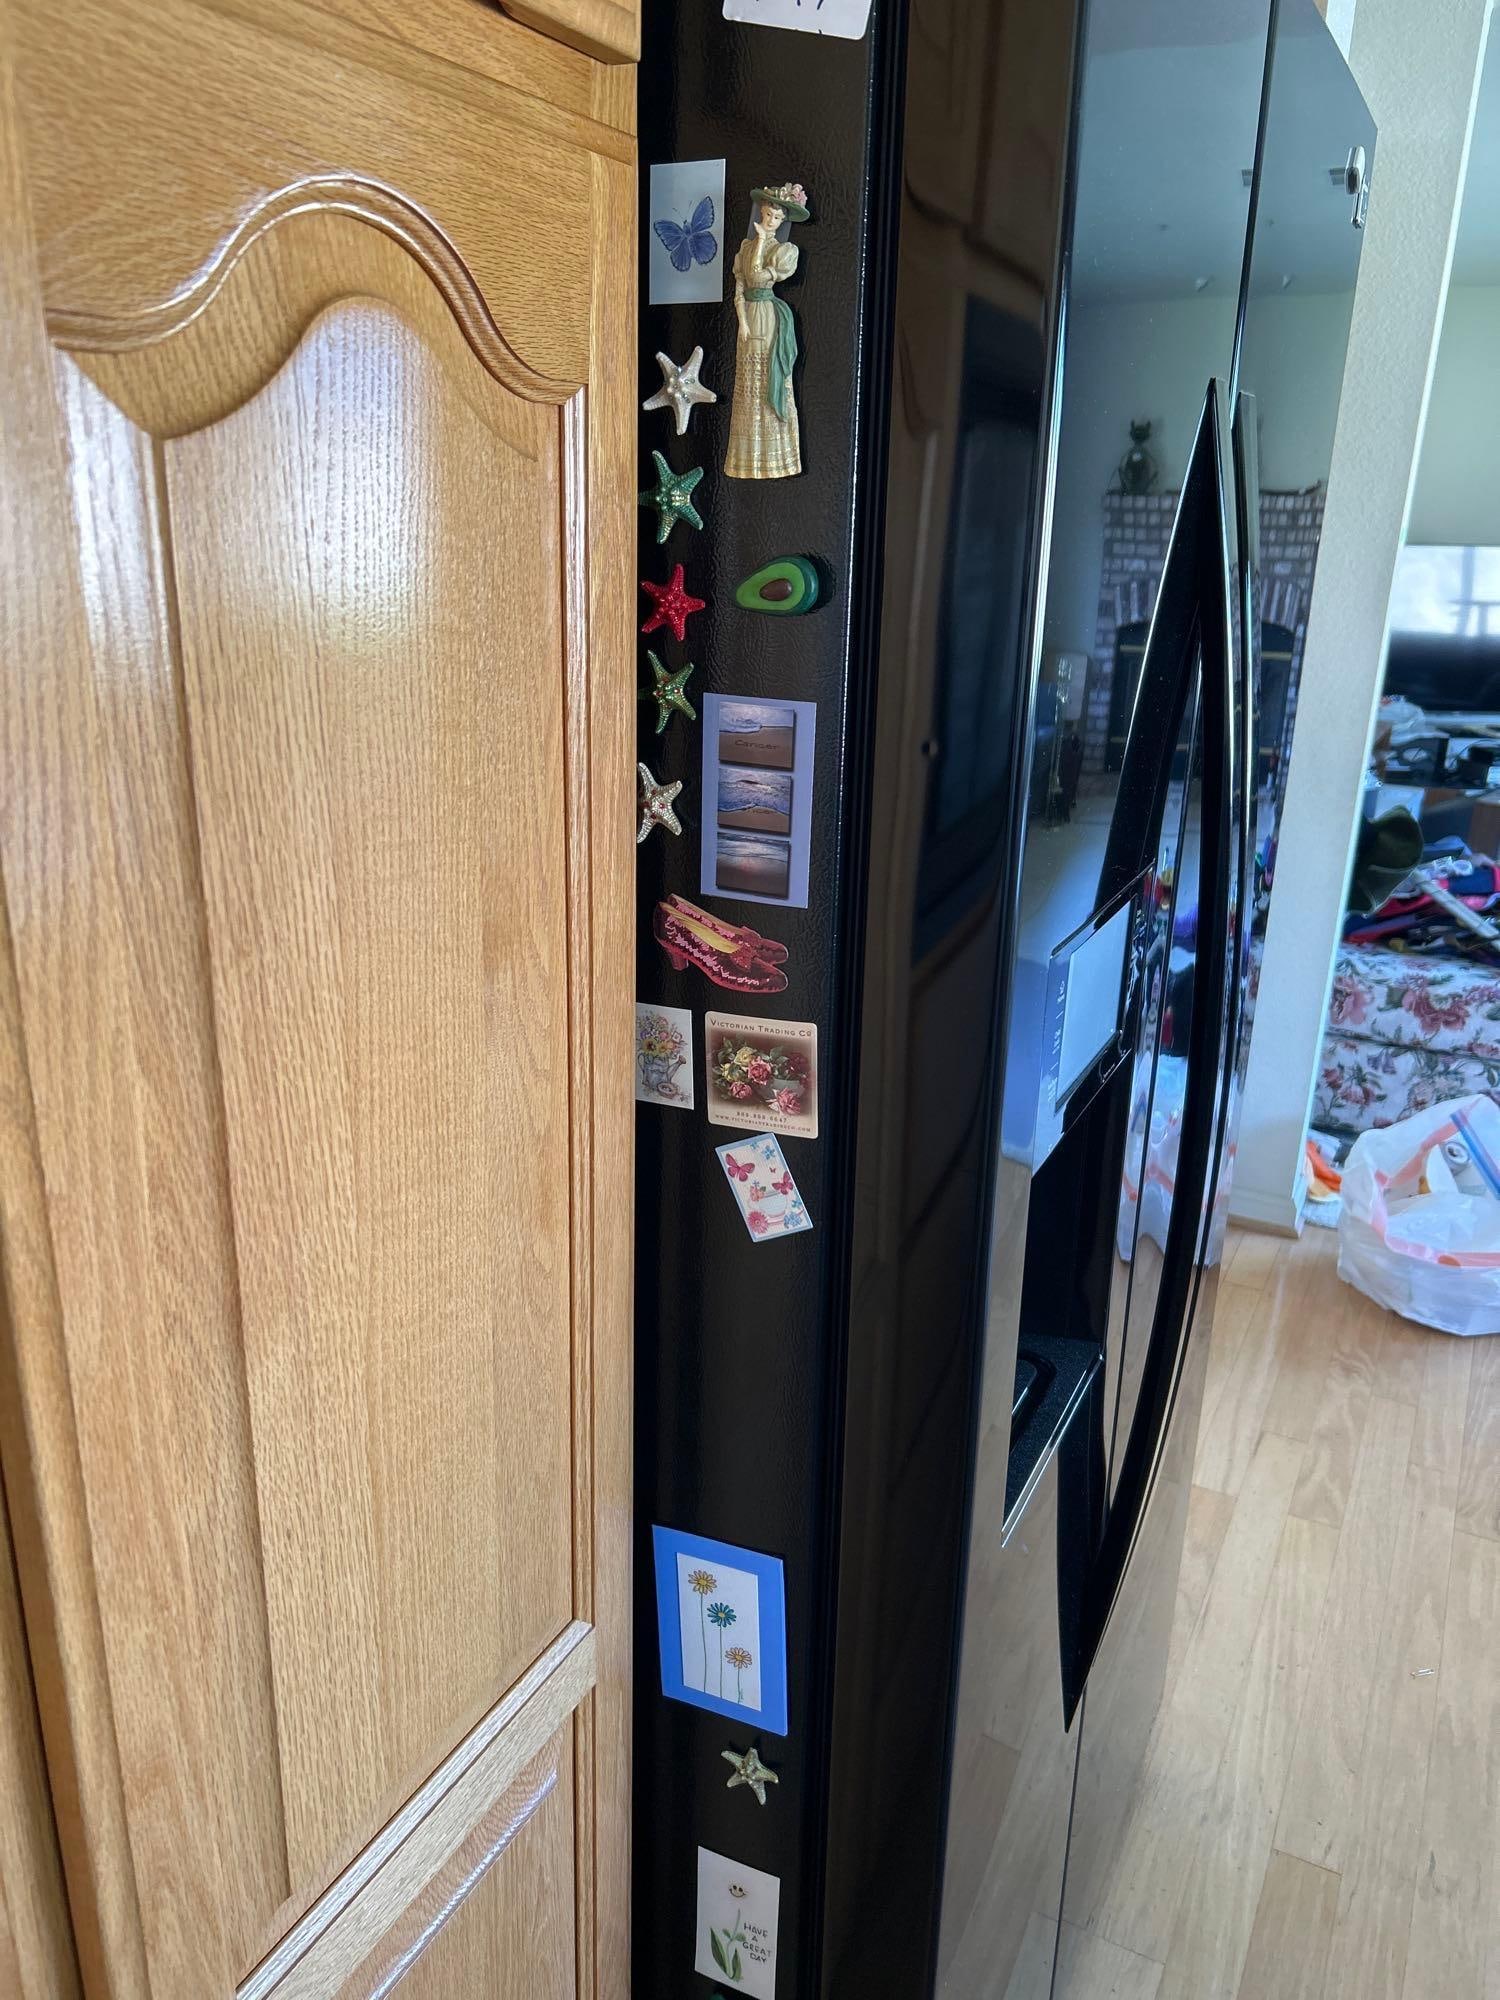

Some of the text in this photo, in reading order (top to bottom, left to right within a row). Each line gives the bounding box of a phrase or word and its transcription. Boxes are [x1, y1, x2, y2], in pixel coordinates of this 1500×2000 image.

[710, 1017, 755, 1031] VICTORIAN
[757, 1025, 796, 1036] TRADING
[743, 1922, 768, 1937] HAVE
[742, 1941, 772, 1957] GREAT
[749, 1952, 767, 1963] DAY
